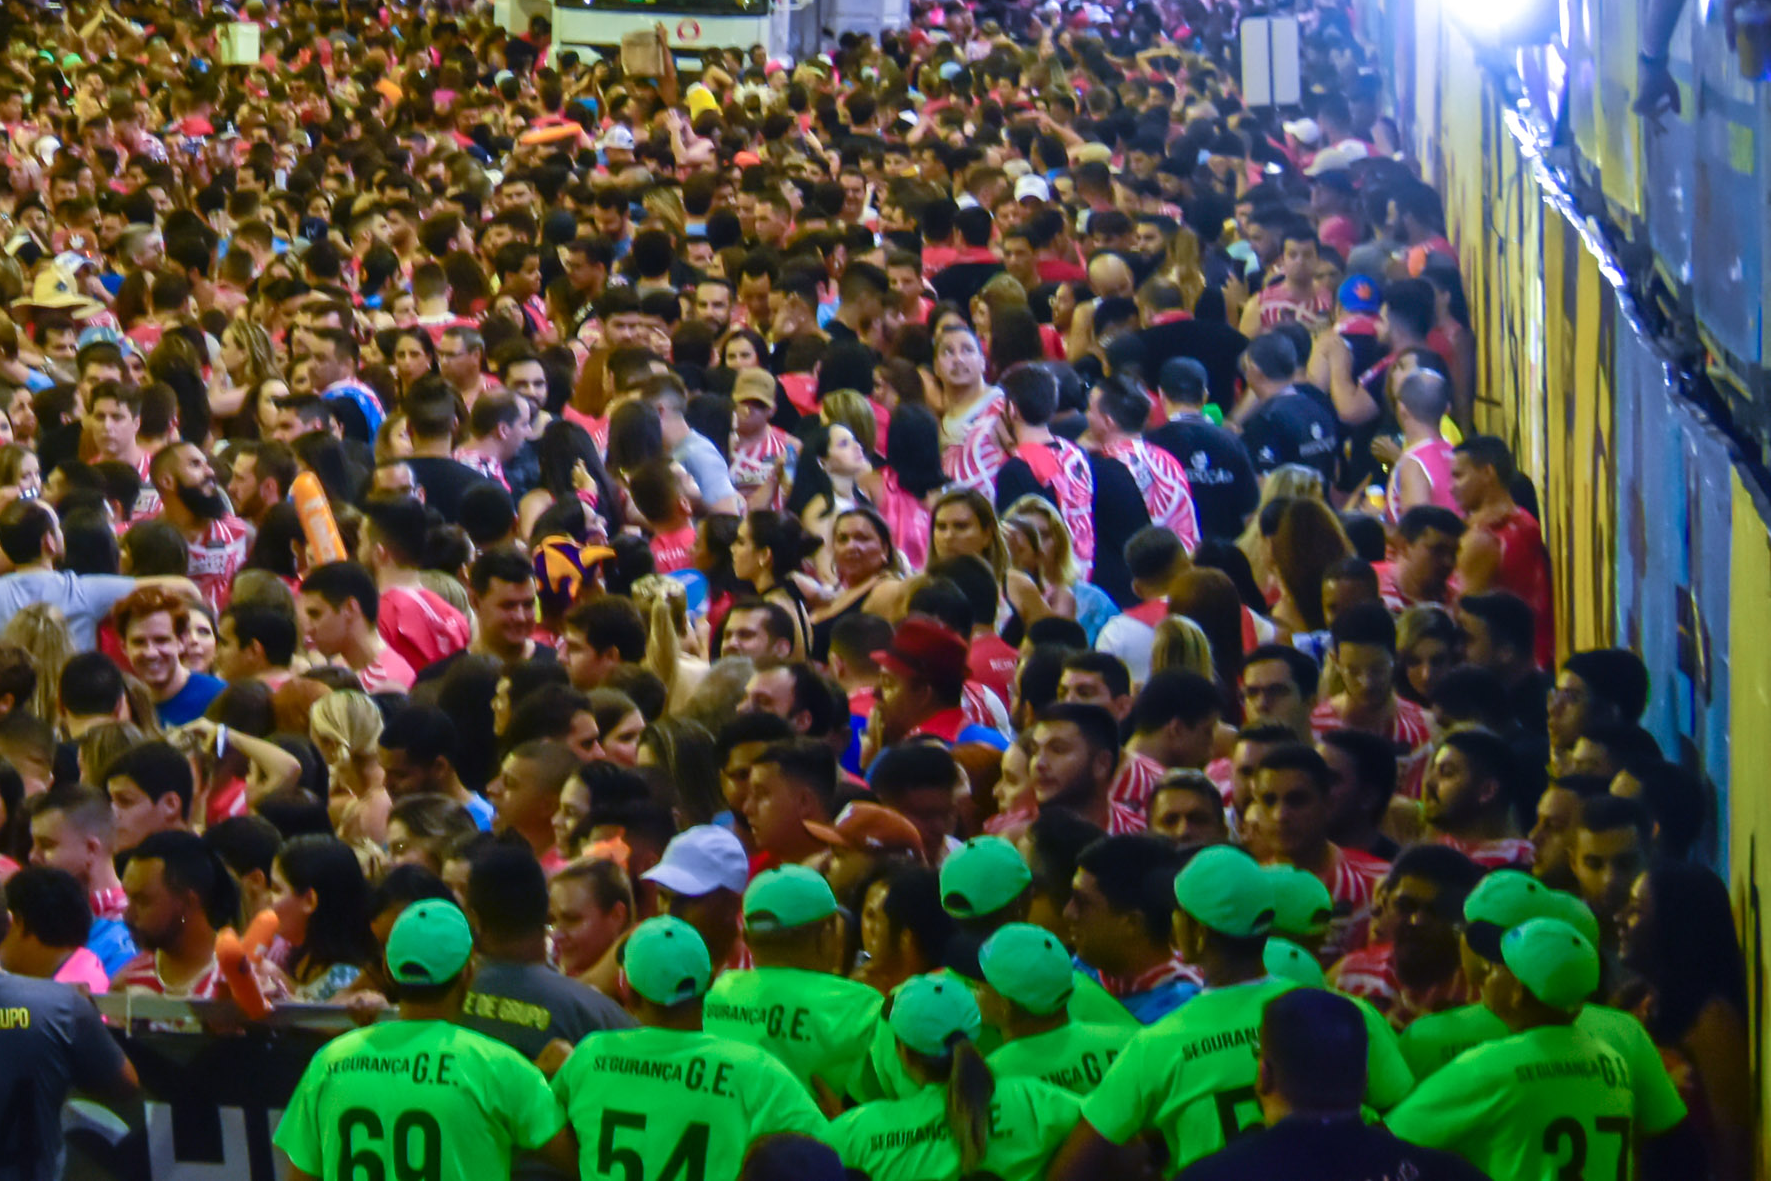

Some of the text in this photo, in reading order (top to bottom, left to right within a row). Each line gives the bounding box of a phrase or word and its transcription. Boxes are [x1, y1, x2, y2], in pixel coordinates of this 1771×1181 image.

[411, 1051, 459, 1087] G.E.
[593, 1054, 736, 1099] SEGURANÇA G.E.
[336, 1105, 442, 1181] 69
[596, 1106, 711, 1181] 54
